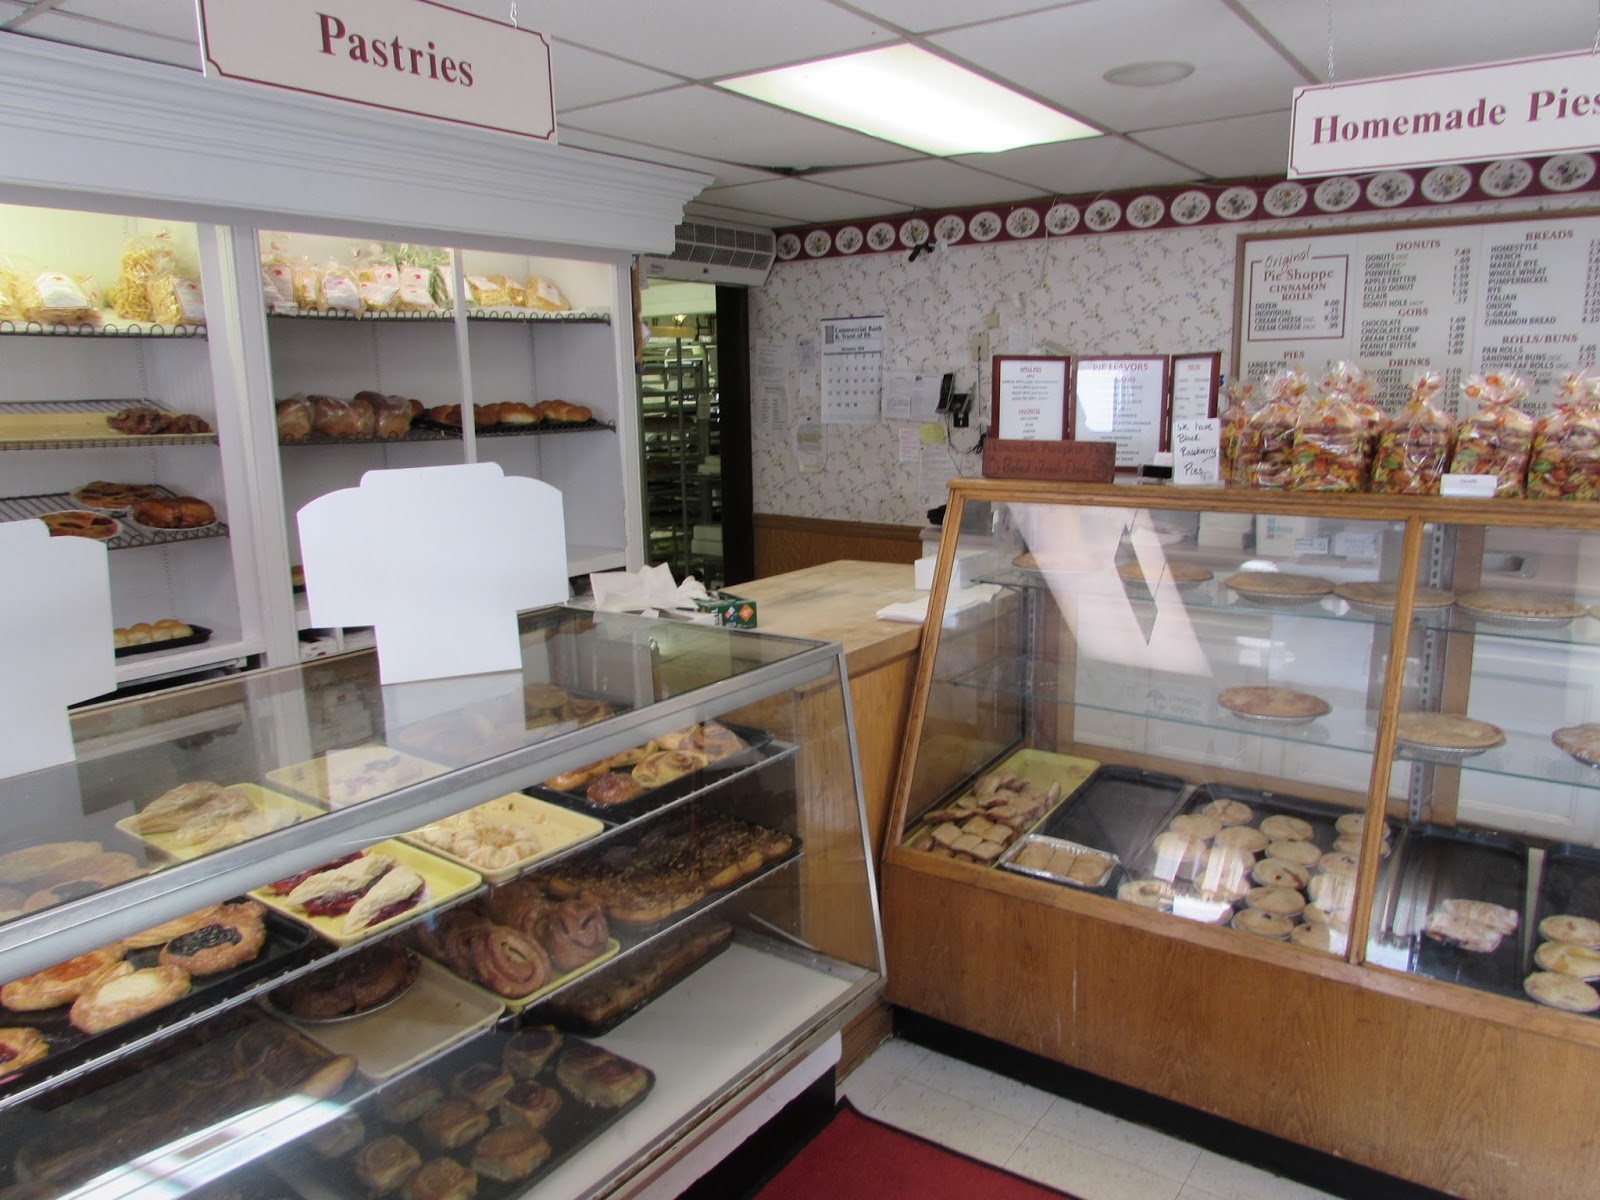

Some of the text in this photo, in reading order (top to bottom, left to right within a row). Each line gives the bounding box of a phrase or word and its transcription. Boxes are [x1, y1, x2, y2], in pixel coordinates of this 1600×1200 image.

[315, 12, 474, 87] Pastries
[1311, 97, 1507, 146] Homemade
[1526, 230, 1573, 240] BREADS
[1396, 240, 1440, 251] DONUTS
[1491, 243, 1538, 252] HOMESTYLE
[1264, 244, 1311, 273] Original
[1490, 260, 1520, 268] MARBLE
[1523, 259, 1538, 267] RYE
[1264, 268, 1334, 283] Pie Shoppe
[1365, 269, 1400, 277] PINWHEEL
[1489, 269, 1517, 277] WHOLE
[1520, 267, 1548, 275] WHEAT
[1388, 275, 1417, 283] FRITTER
[1488, 276, 1547, 285] PUMPERNICKEL
[1269, 282, 1326, 293] CINNAMON
[1282, 292, 1313, 301] ROLLS
[1255, 302, 1277, 310] DOZEN
[1363, 300, 1388, 308] DONUT
[1389, 299, 1408, 307] HOLE
[1398, 308, 1428, 316] GOBS
[1255, 316, 1276, 324] CREAM
[1484, 318, 1527, 326] CINNAMON
[1502, 334, 1577, 344] ROLLS/BUNS
[1360, 342, 1388, 350] PEANUT
[1482, 346, 1498, 354] PAN
[1284, 351, 1304, 359] PIES
[1482, 354, 1523, 362] SANDWICH
[1109, 363, 1149, 371] FLAVORS
[1389, 358, 1430, 367] DRINKS
[1183, 462, 1202, 476] Pies
